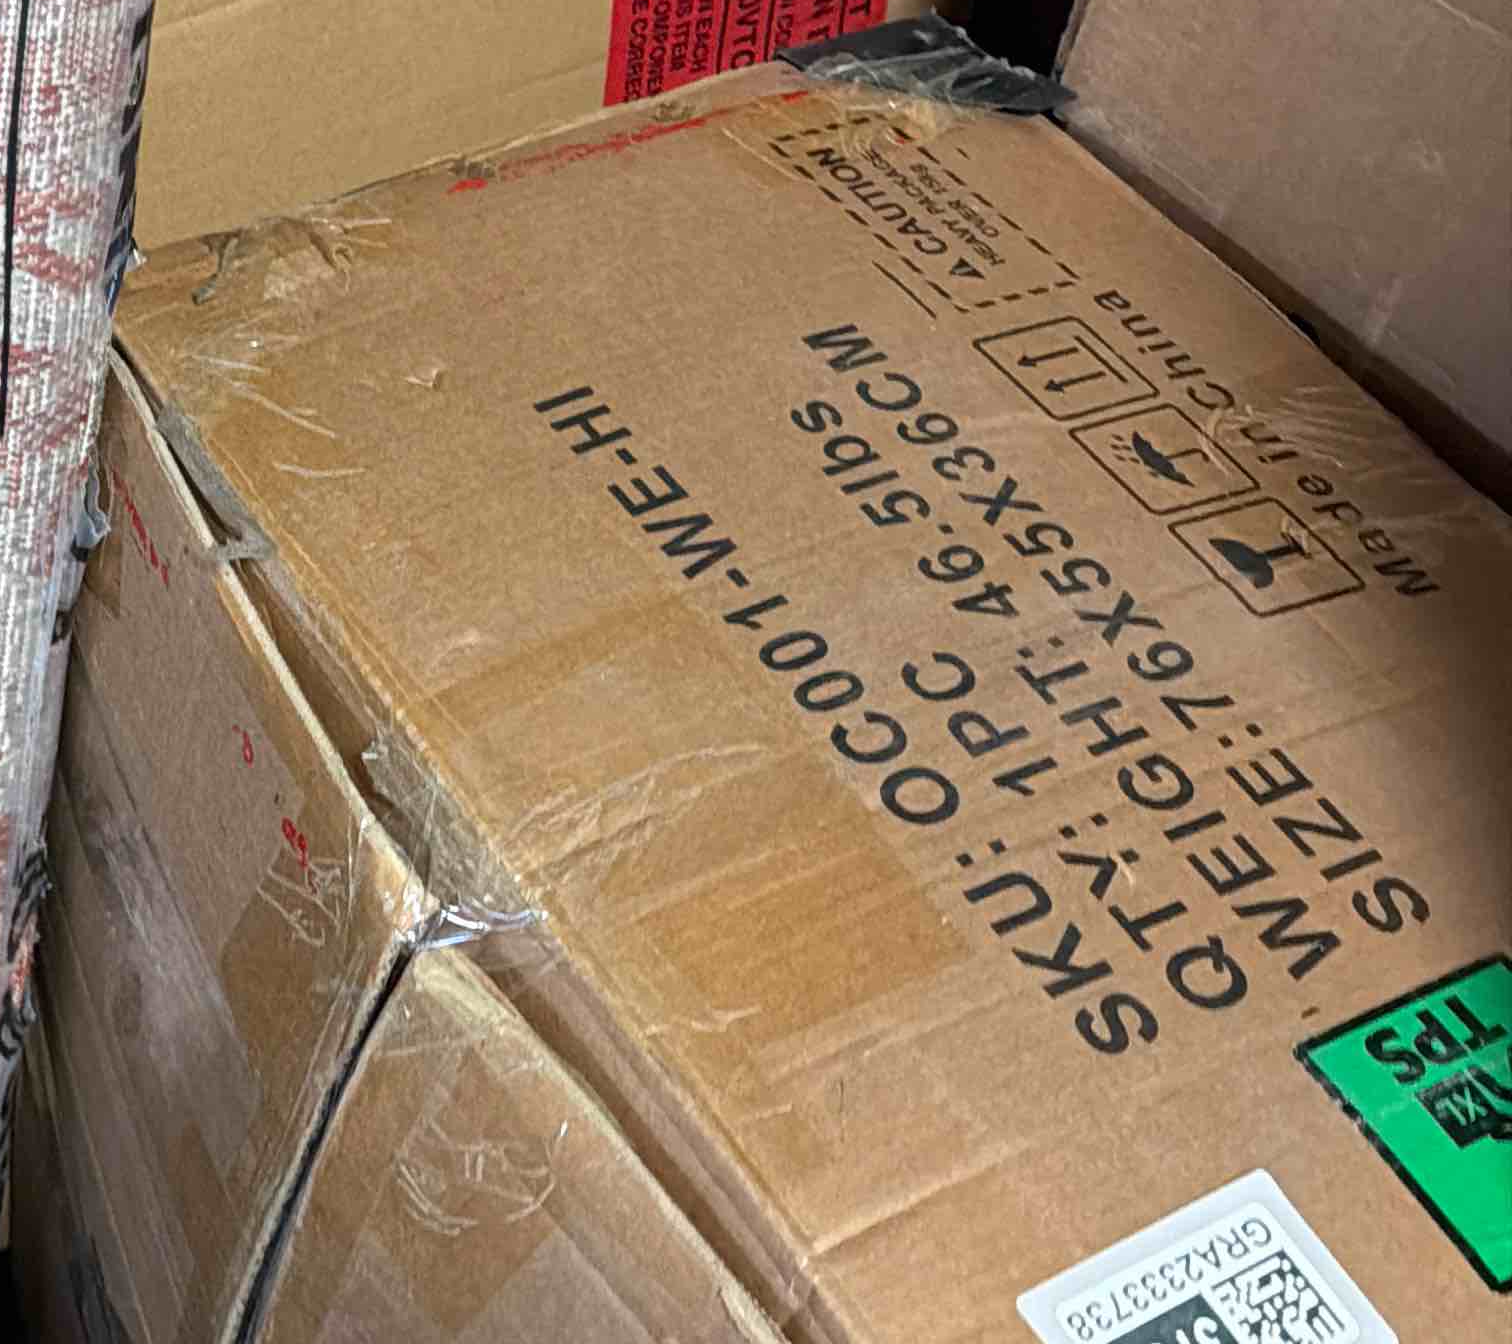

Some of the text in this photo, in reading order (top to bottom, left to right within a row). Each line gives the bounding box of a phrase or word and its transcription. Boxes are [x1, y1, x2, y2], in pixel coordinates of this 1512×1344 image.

[689, 16, 714, 72] EACH
[807, 146, 948, 256] CAUTION
[864, 147, 1006, 267] HEAVY PACKAGE
[948, 198, 1000, 238] OVER
[1093, 289, 1441, 597] Made in China
[532, 385, 1160, 1056] SKU: OC001-WE-HI
[790, 399, 1342, 982] WEIGHT: 46.5lbs
[901, 650, 1249, 1010] QTY: 1PC
[1364, 994, 1509, 1086] TPS
[1434, 1085, 1488, 1127] XL
[1067, 1215, 1273, 1343] GRA2333738
